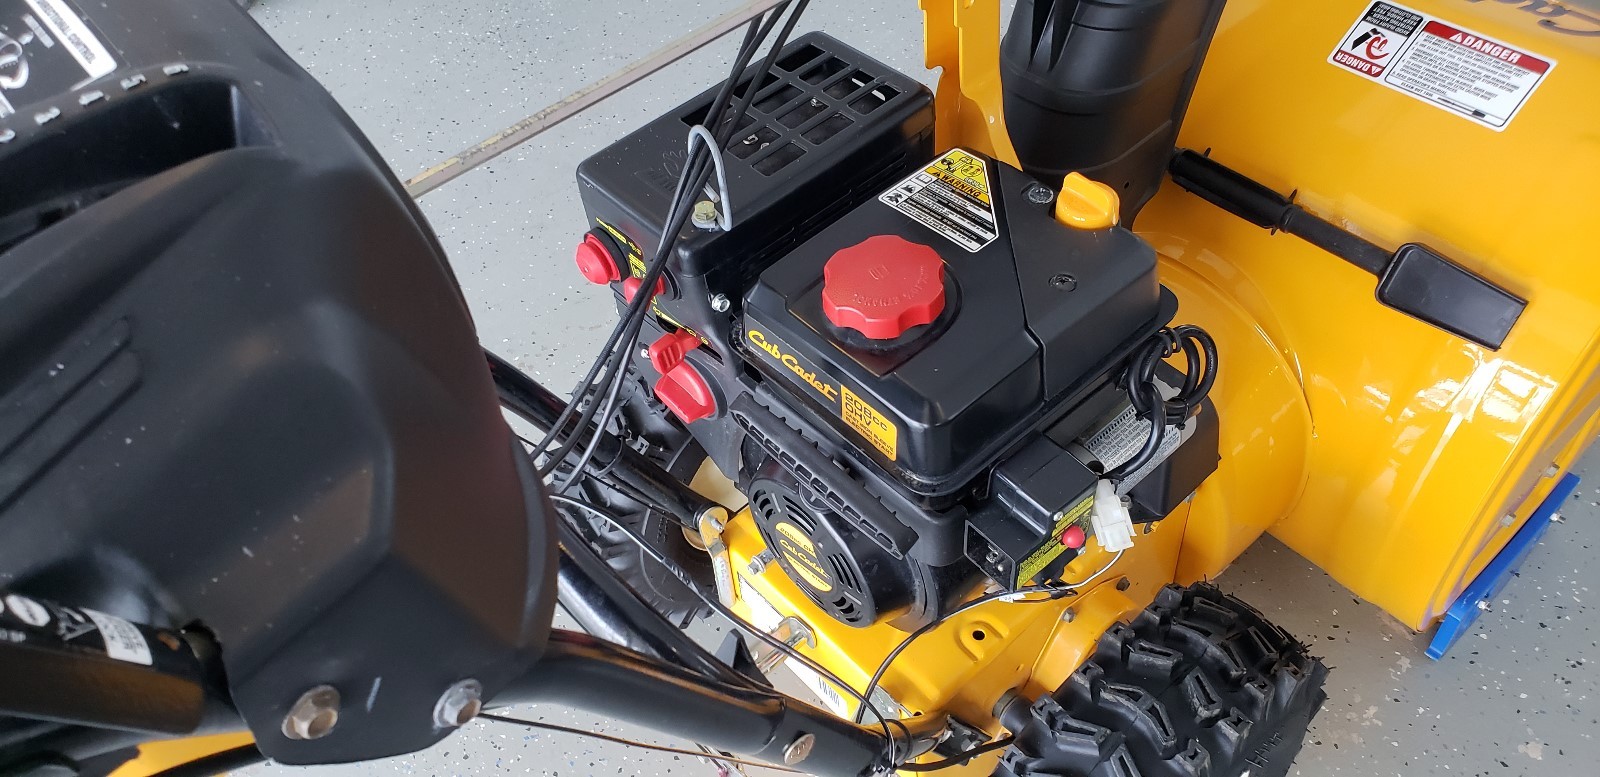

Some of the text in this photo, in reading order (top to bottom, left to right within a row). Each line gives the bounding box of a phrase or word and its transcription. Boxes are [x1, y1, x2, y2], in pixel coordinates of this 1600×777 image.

[1333, 52, 1372, 71] DANGER
[1460, 35, 1522, 63] DANGER
[941, 174, 981, 197] WARNING
[748, 330, 838, 403] Cub Cadet
[845, 393, 888, 431] 208cc
[845, 403, 872, 427] OHV
